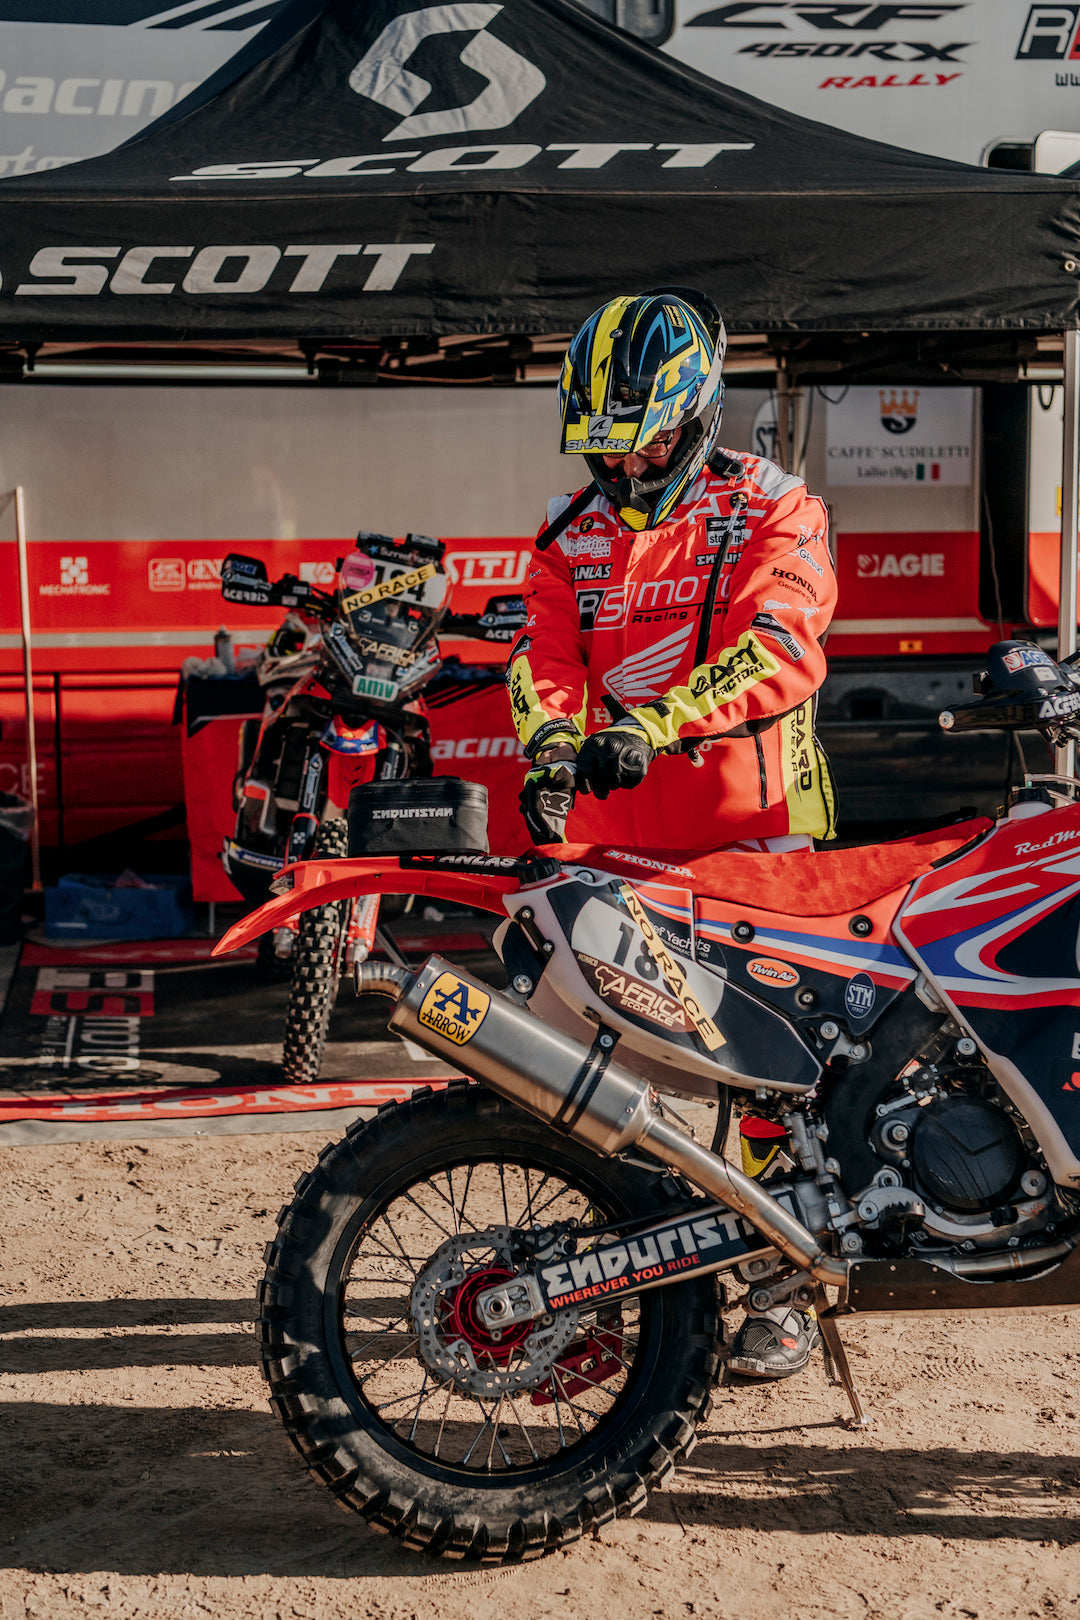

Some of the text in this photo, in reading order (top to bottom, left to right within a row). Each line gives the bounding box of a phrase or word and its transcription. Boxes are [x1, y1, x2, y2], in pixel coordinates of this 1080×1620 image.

[684, 3, 968, 31] CRF
[734, 41, 980, 63] 450RX
[0, 68, 200, 117] acin
[818, 72, 964, 90] RALLY
[168, 142, 756, 182] SCOTT
[14, 242, 436, 296] SCOTT
[565, 437, 634, 451] SHARK
[882, 445, 970, 459] SCUDELETTI
[880, 553, 945, 578] AGIE
[39, 584, 111, 596] MECHATRONIC
[346, 593, 373, 611] NO
[378, 567, 430, 597] RACE
[770, 566, 818, 603] HONDA
[632, 610, 688, 624] Racing
[439, 855, 518, 869] ANLAS
[622, 853, 695, 878] HONDA
[628, 896, 654, 941] NO
[655, 950, 715, 1040] RACE
[751, 963, 797, 983] Twin Air
[603, 976, 686, 1027] AFRICA
[847, 984, 874, 1008] STM
[421, 1008, 471, 1042] ARROW
[50, 1083, 425, 1116] HOND
[549, 1253, 701, 1310] WHEREVER YOU RIDE
